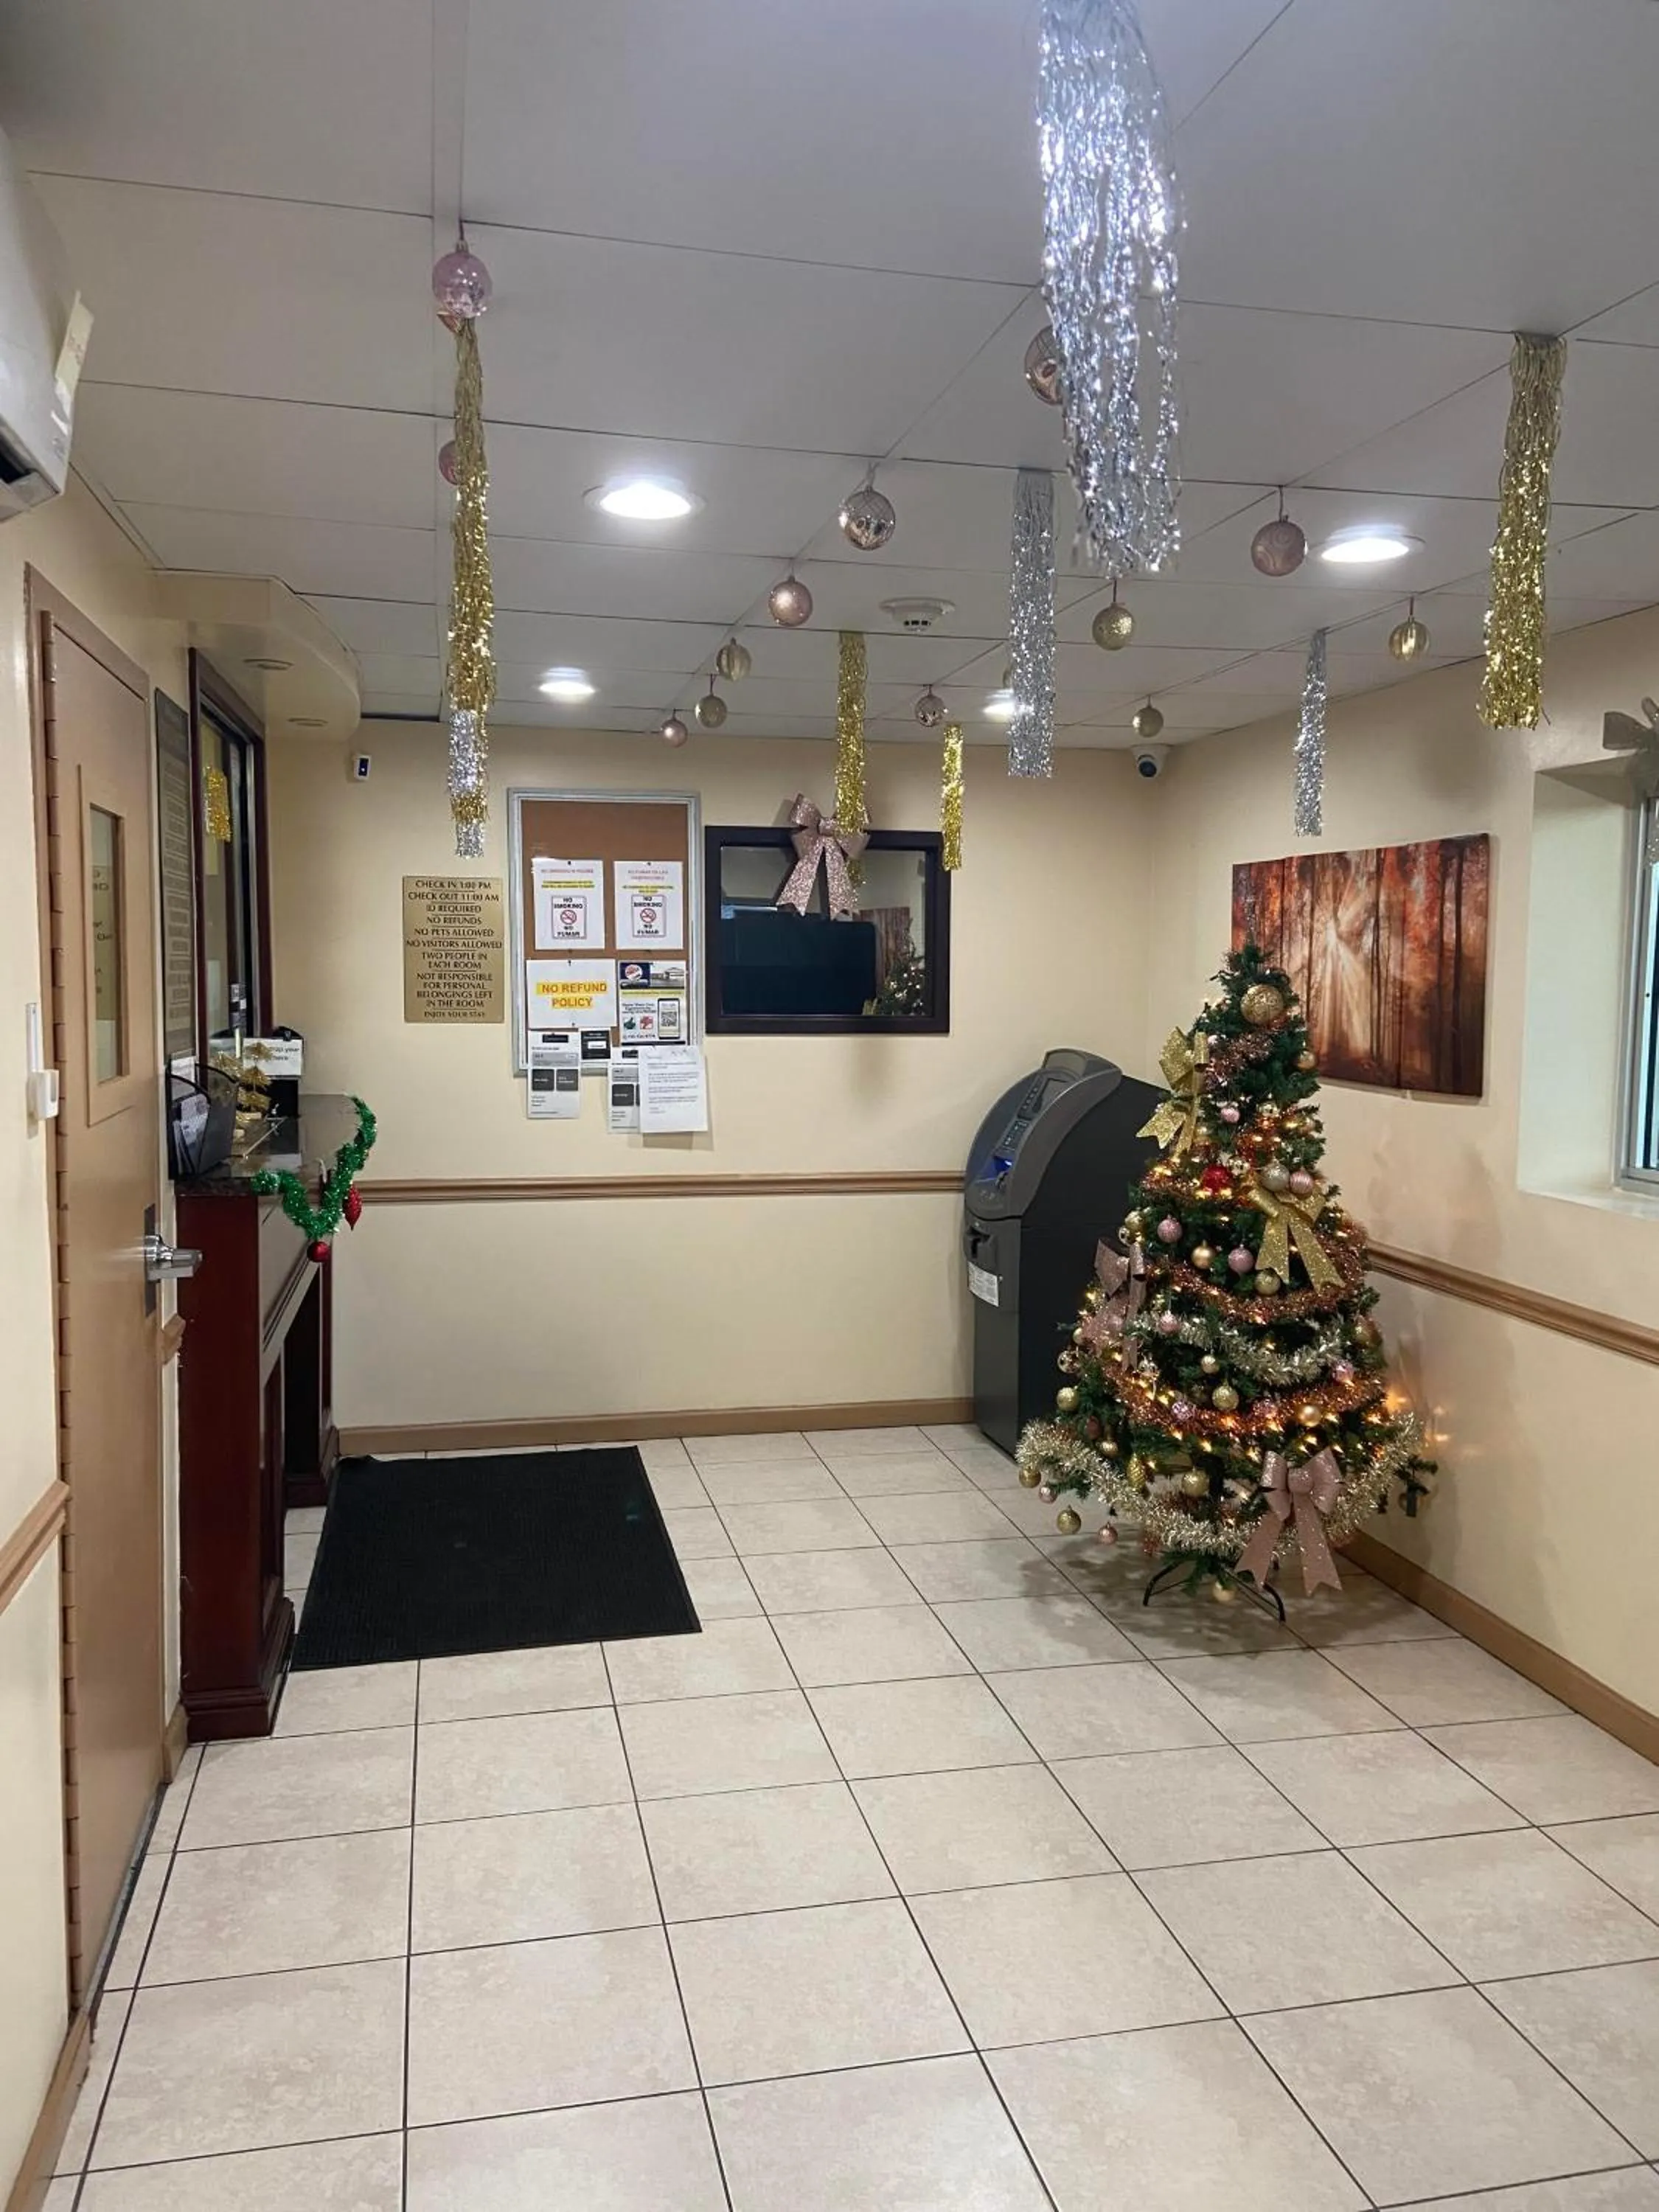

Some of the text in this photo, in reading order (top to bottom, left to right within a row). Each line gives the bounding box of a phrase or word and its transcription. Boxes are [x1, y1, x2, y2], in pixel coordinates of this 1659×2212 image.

[415, 880, 445, 888] CHECK
[448, 880, 457, 888] IN
[478, 881, 492, 889] PM
[408, 891, 437, 900] CHECK
[439, 892, 458, 900] OUT
[484, 894, 499, 902] AM
[438, 905, 482, 913] REQUIRED
[443, 917, 482, 925] REFUNDS
[452, 928, 494, 936] ALLOWED
[420, 939, 459, 948] VISITORS
[461, 940, 502, 949] ALLOWED
[422, 952, 443, 960] TWO
[445, 952, 476, 960] PEOPLE
[453, 961, 481, 969] ROOM
[437, 973, 493, 981] RESPONSIBLE
[443, 981, 486, 990] PERSONAL
[542, 983, 607, 993] NO REFUND
[417, 990, 473, 998] BELONGINGS
[425, 999, 485, 1007] IN THE ROOM
[552, 997, 593, 1007] POLICY
